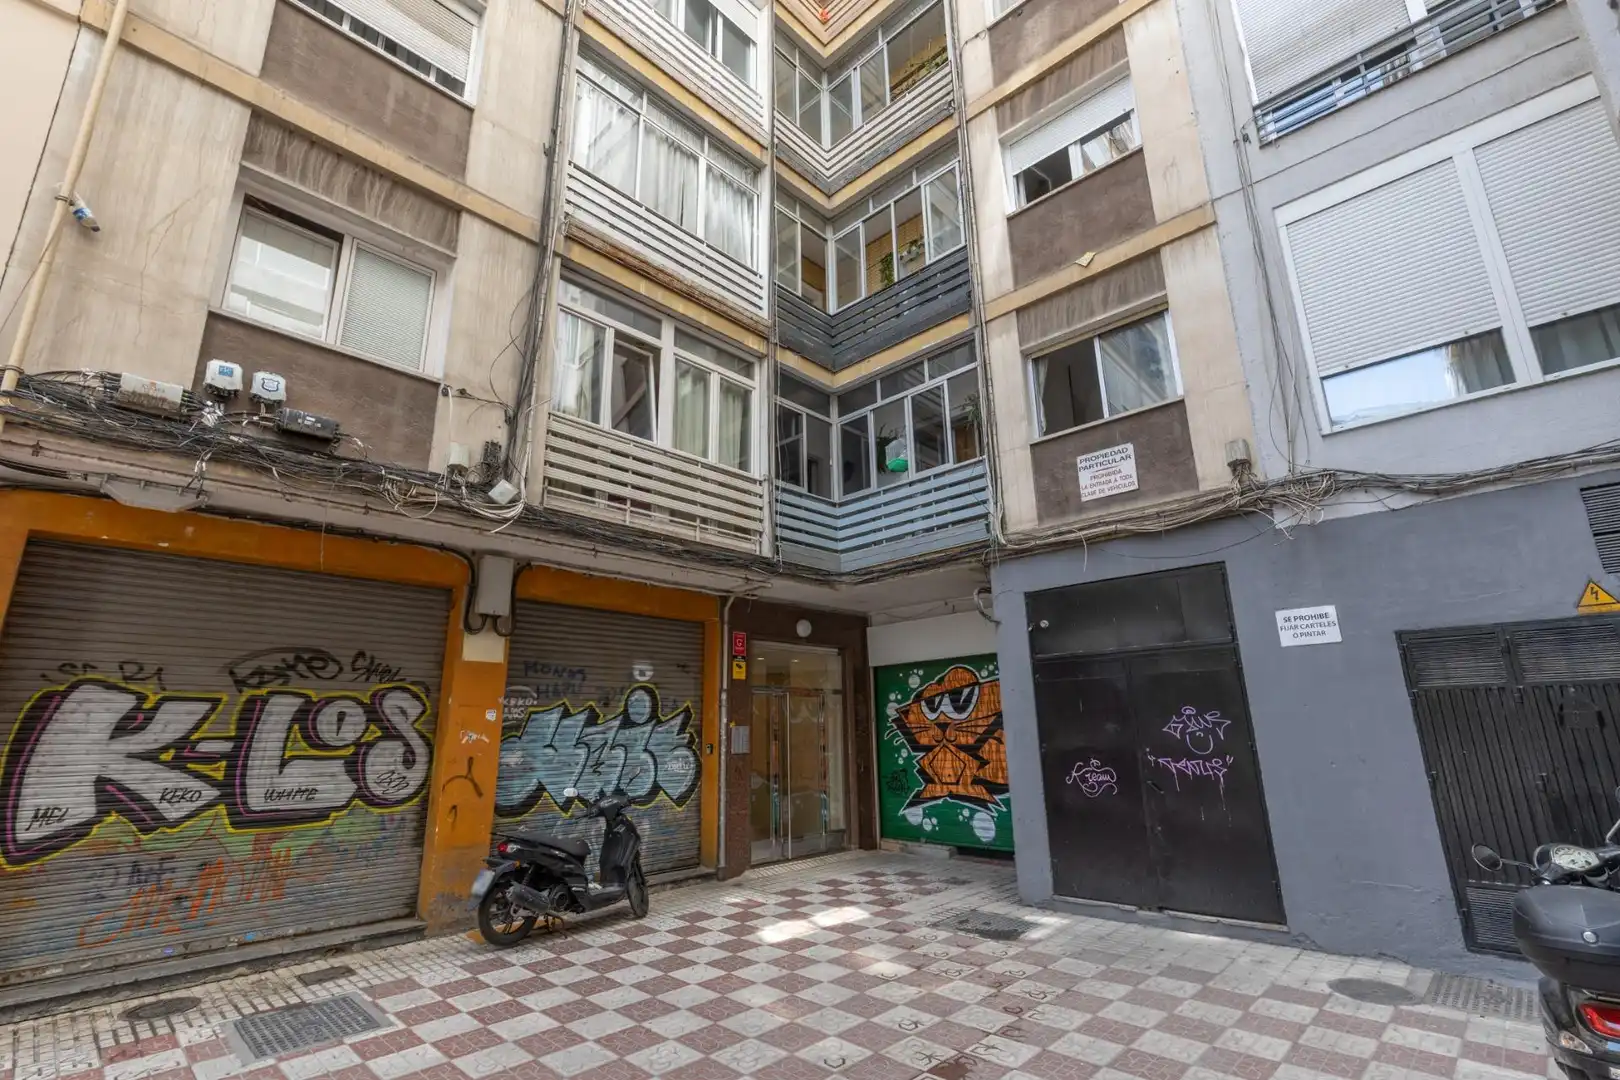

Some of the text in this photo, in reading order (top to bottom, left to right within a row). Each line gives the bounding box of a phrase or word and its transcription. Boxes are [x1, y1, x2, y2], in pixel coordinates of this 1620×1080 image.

[1080, 447, 1128, 464] PROPIEDAD
[1079, 454, 1132, 472] PARTICULAR
[1293, 612, 1330, 622] PROHIBE
[1280, 620, 1337, 632] FIJAR CARTELES
[1300, 630, 1327, 638] PINTAR
[158, 787, 202, 804] KEKO
